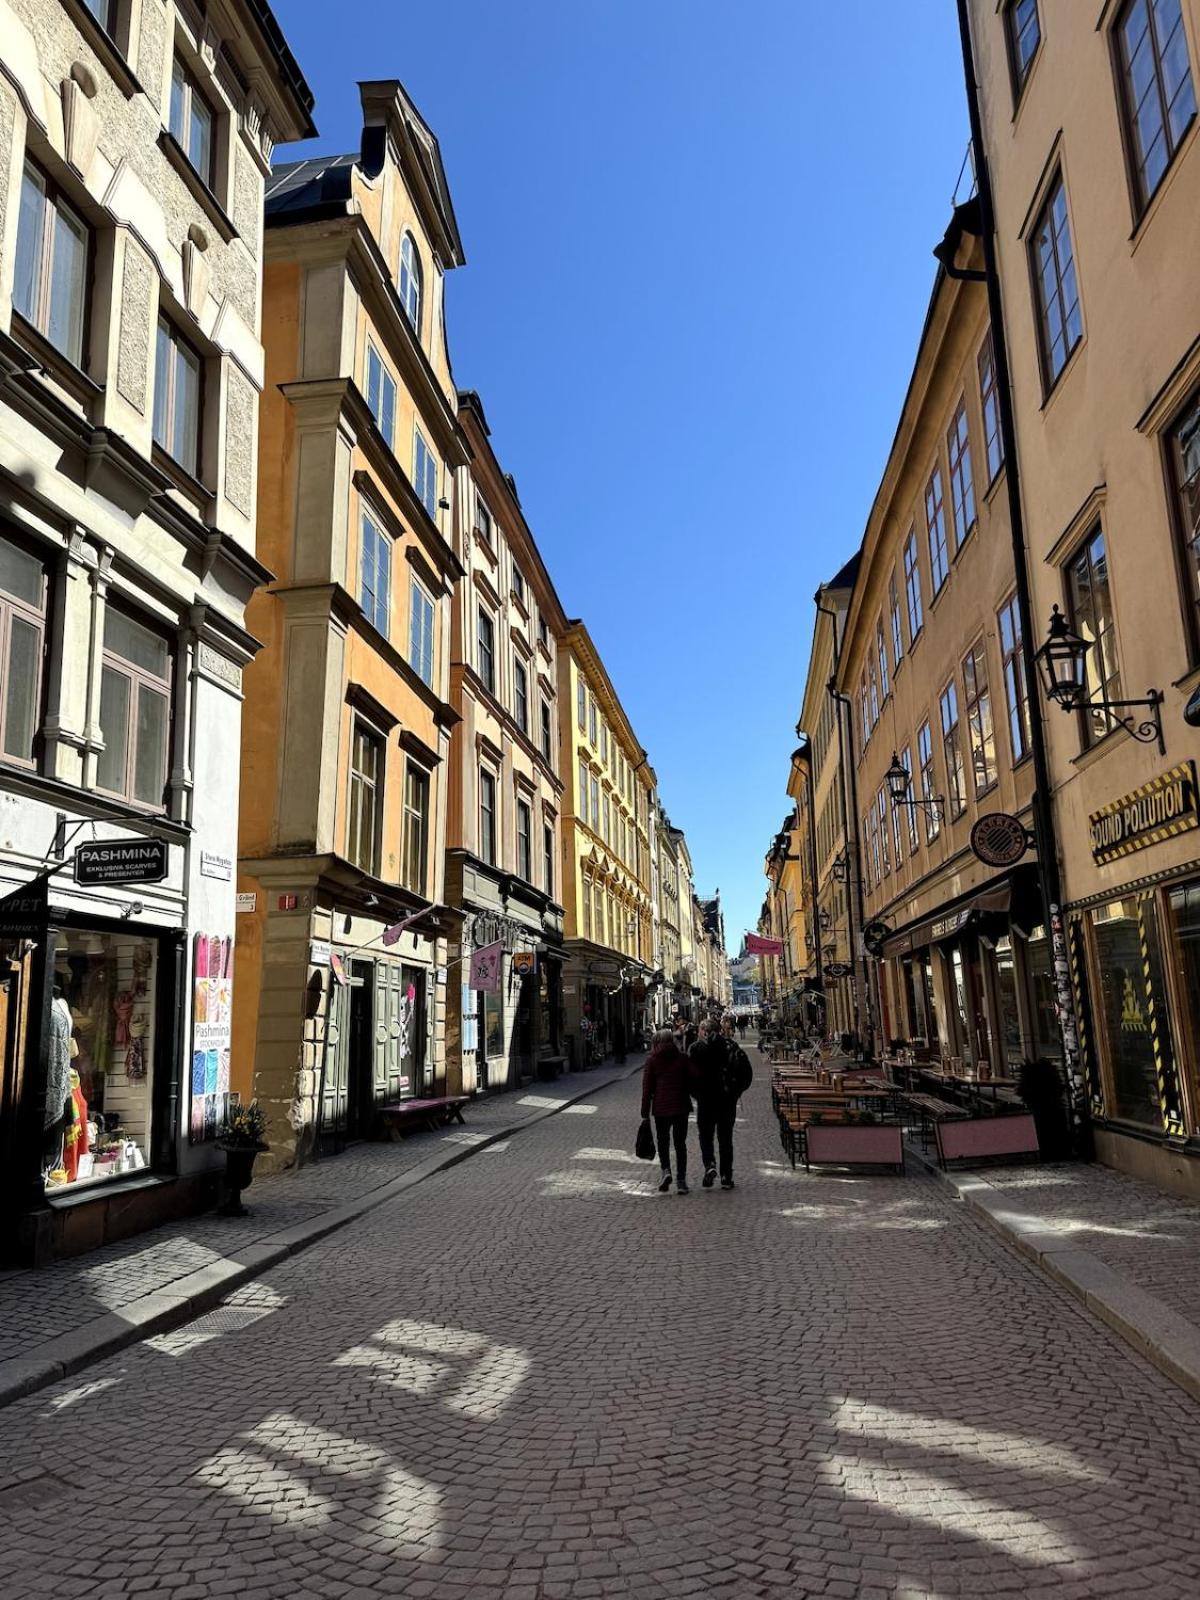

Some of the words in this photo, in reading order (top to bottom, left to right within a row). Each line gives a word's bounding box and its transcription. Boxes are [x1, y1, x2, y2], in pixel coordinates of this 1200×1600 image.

[1090, 813, 1122, 851] SOUND
[1124, 780, 1184, 837] POLLUTION
[81, 847, 161, 862] PASHMINA
[125, 862, 157, 870] SCARVES
[104, 870, 145, 878] PRESENTER
[196, 1024, 229, 1037] Pashmina
